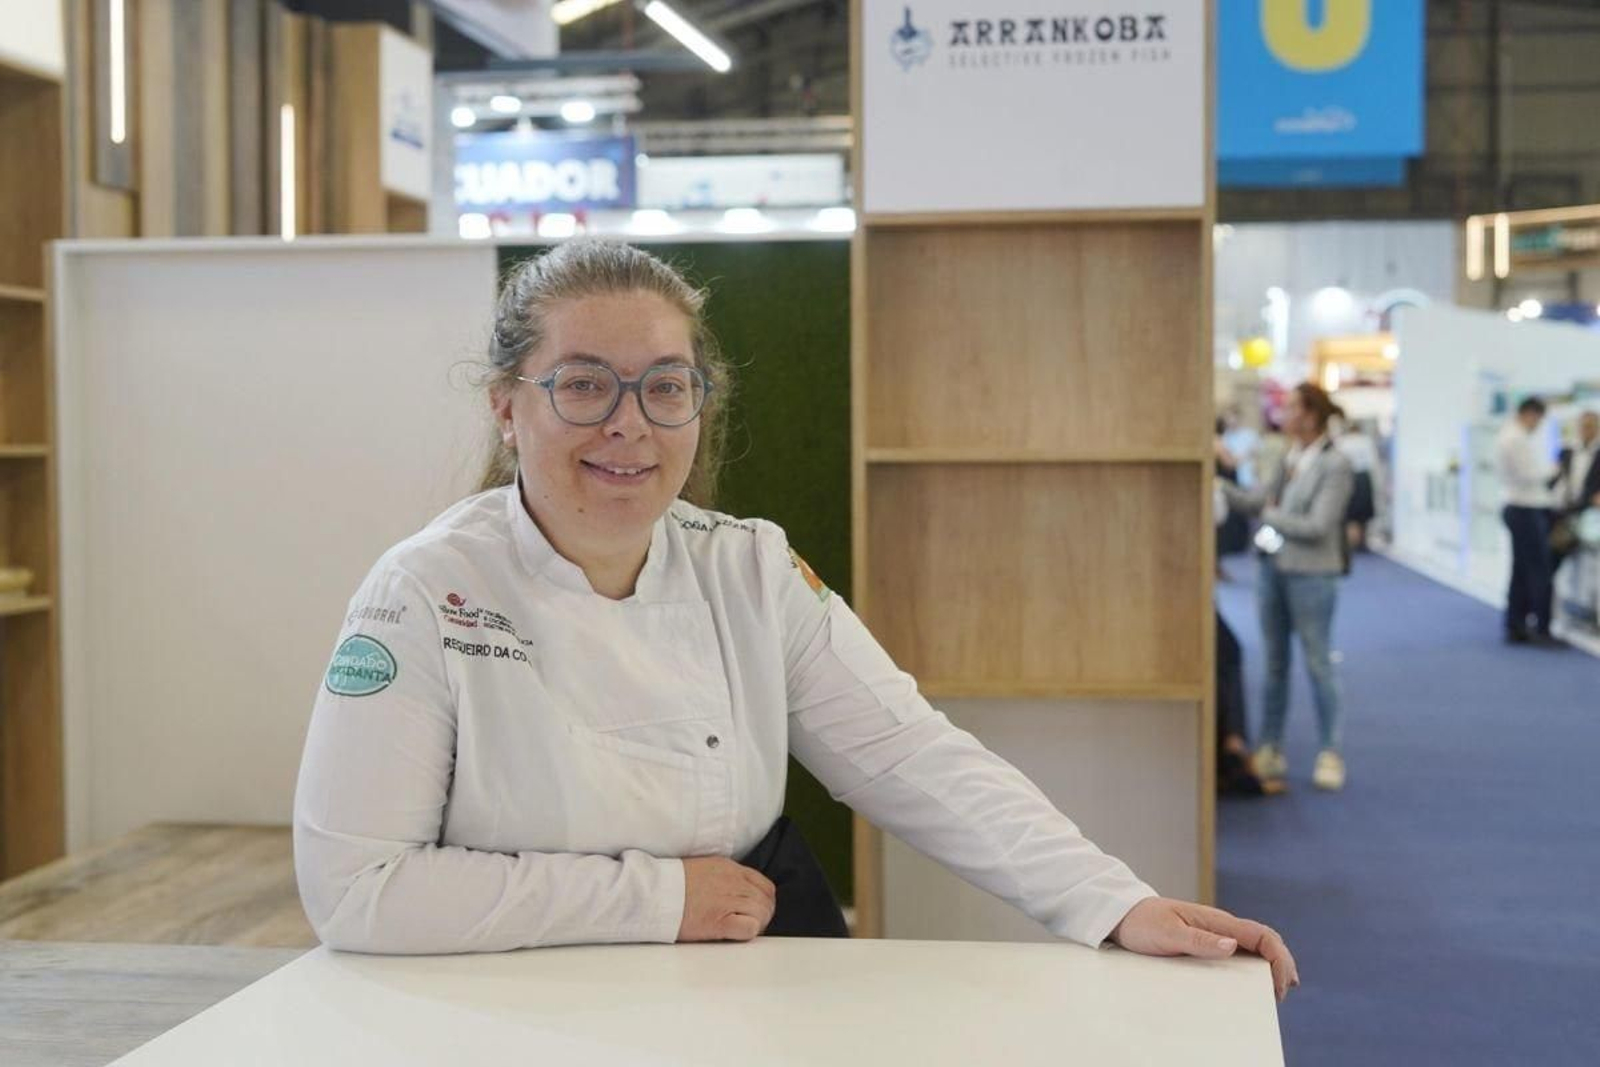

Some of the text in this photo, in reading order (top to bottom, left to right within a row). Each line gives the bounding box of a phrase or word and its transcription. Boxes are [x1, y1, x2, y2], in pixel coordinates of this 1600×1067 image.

[950, 16, 1166, 47] ARRANKOBA
[458, 607, 479, 618] Food
[494, 646, 510, 659] DA
